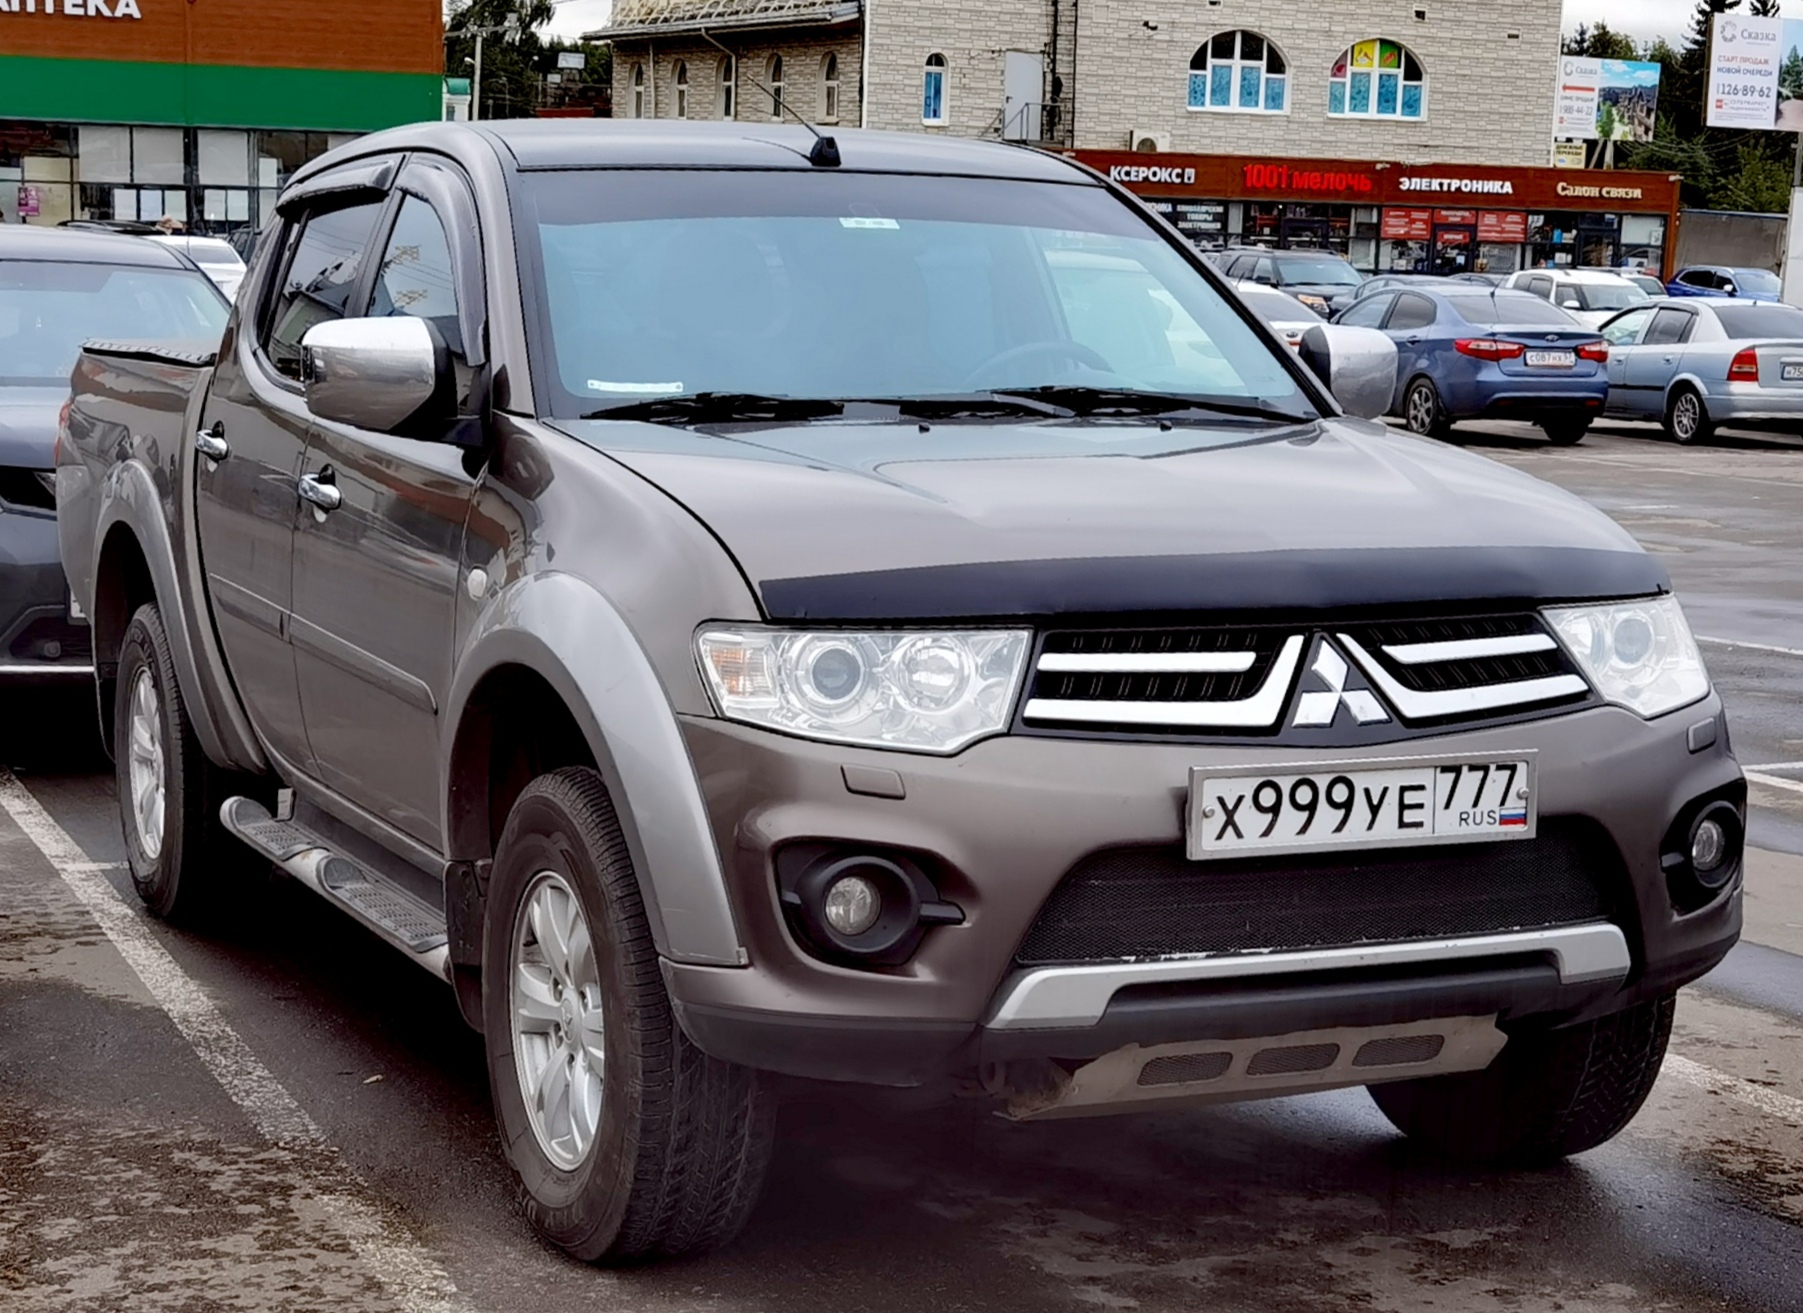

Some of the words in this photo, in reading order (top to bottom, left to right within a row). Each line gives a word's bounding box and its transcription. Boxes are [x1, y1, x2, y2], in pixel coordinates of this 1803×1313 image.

[1740, 28, 1777, 42] Сказка
[1717, 54, 1738, 64] СТАРТ
[1739, 56, 1770, 65] ПРОДАЖ
[1716, 65, 1741, 75] НОВОЙ
[1742, 67, 1773, 77] ОЧЕРЕДИ
[1110, 165, 1182, 183] КСЕРОКС
[1243, 163, 1289, 188] 1001
[1399, 176, 1513, 194] ЭЛЕКТРОНИКА
[1556, 181, 1600, 198] Салон
[1601, 184, 1642, 199] связи
[1214, 775, 1427, 841] Х999УЕ
[1439, 763, 1518, 811] 777
[1458, 810, 1498, 827] RUS
